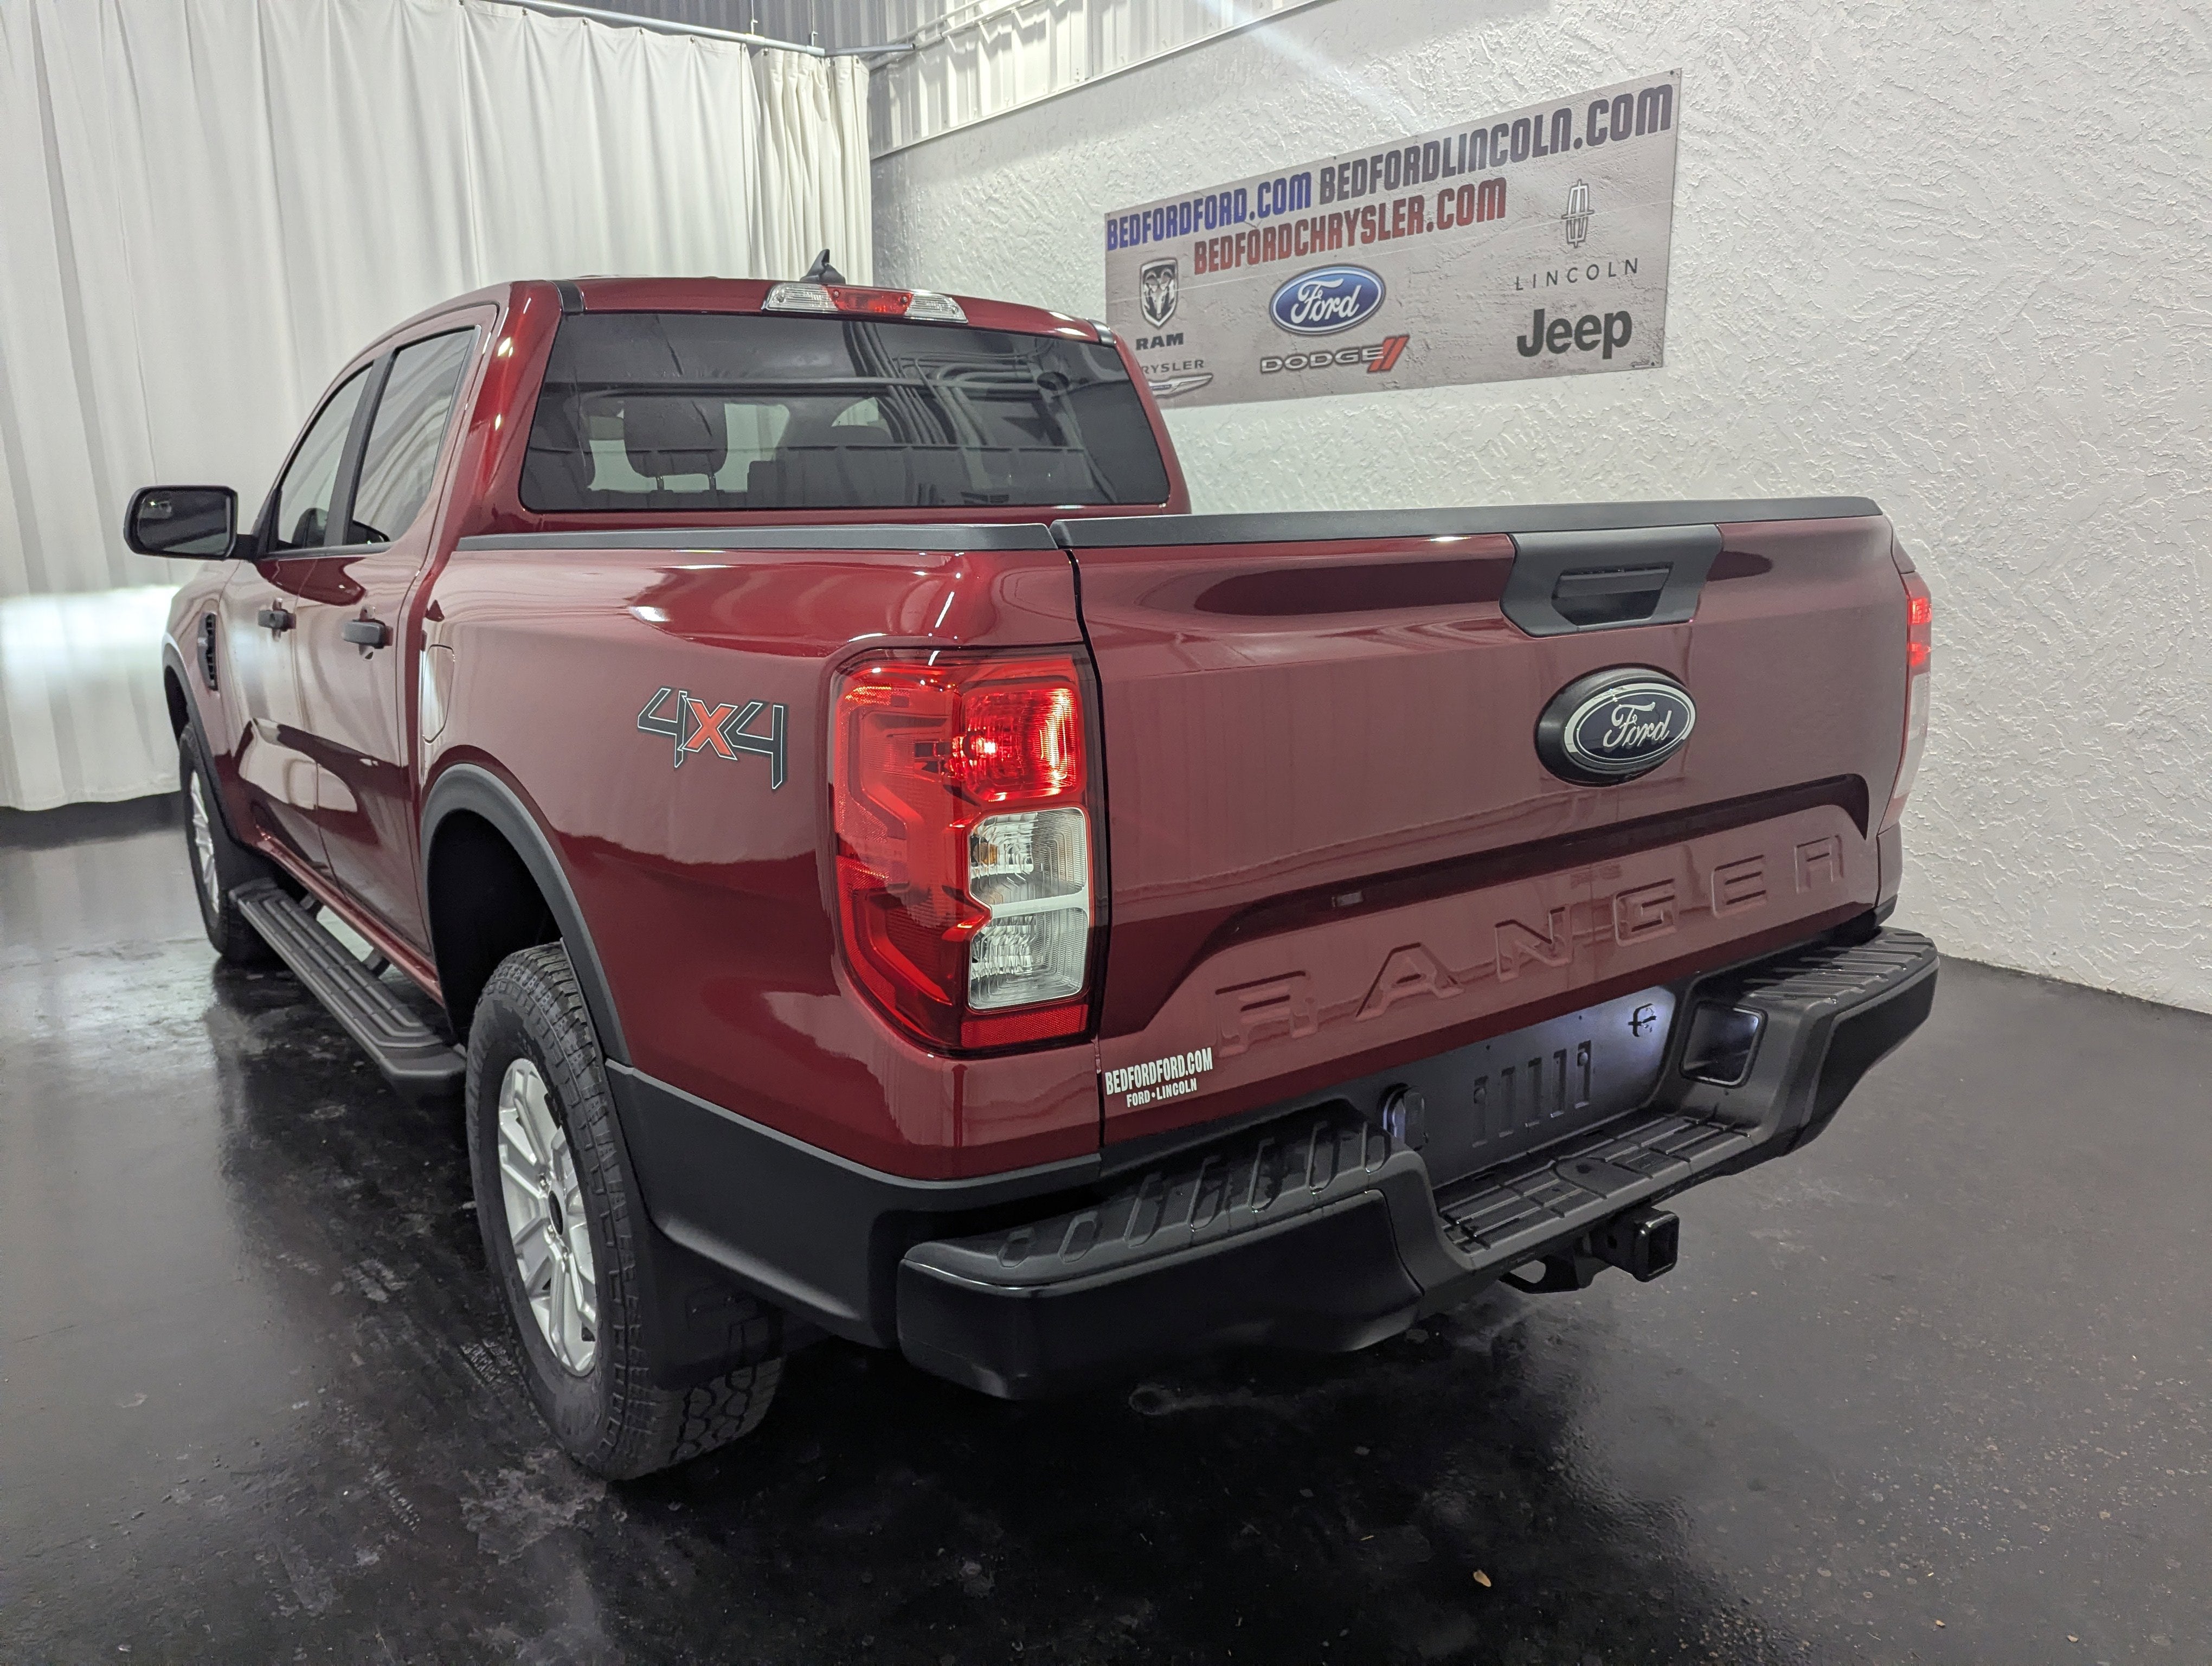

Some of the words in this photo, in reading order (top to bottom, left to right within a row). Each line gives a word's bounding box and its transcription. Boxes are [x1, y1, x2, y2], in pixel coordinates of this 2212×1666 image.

[1107, 171, 1311, 251] BEDFORDFORD.COM
[1320, 84, 1674, 205] BEDFORDLINCOLN.COM
[1194, 177, 1507, 275] BEDFORDCHRYSLER.COM
[1516, 258, 1638, 291] LINCOLN
[1290, 278, 1362, 324] Ford
[1136, 332, 1184, 351] RAM
[1517, 307, 1632, 360] Jeep
[1141, 359, 1205, 374] RYSLER
[1260, 346, 1385, 374] DODGE
[1602, 702, 1673, 748] Ford
[1215, 834, 1844, 1058] RANGER
[1104, 1047, 1213, 1095] BEDFORDFORD.COM
